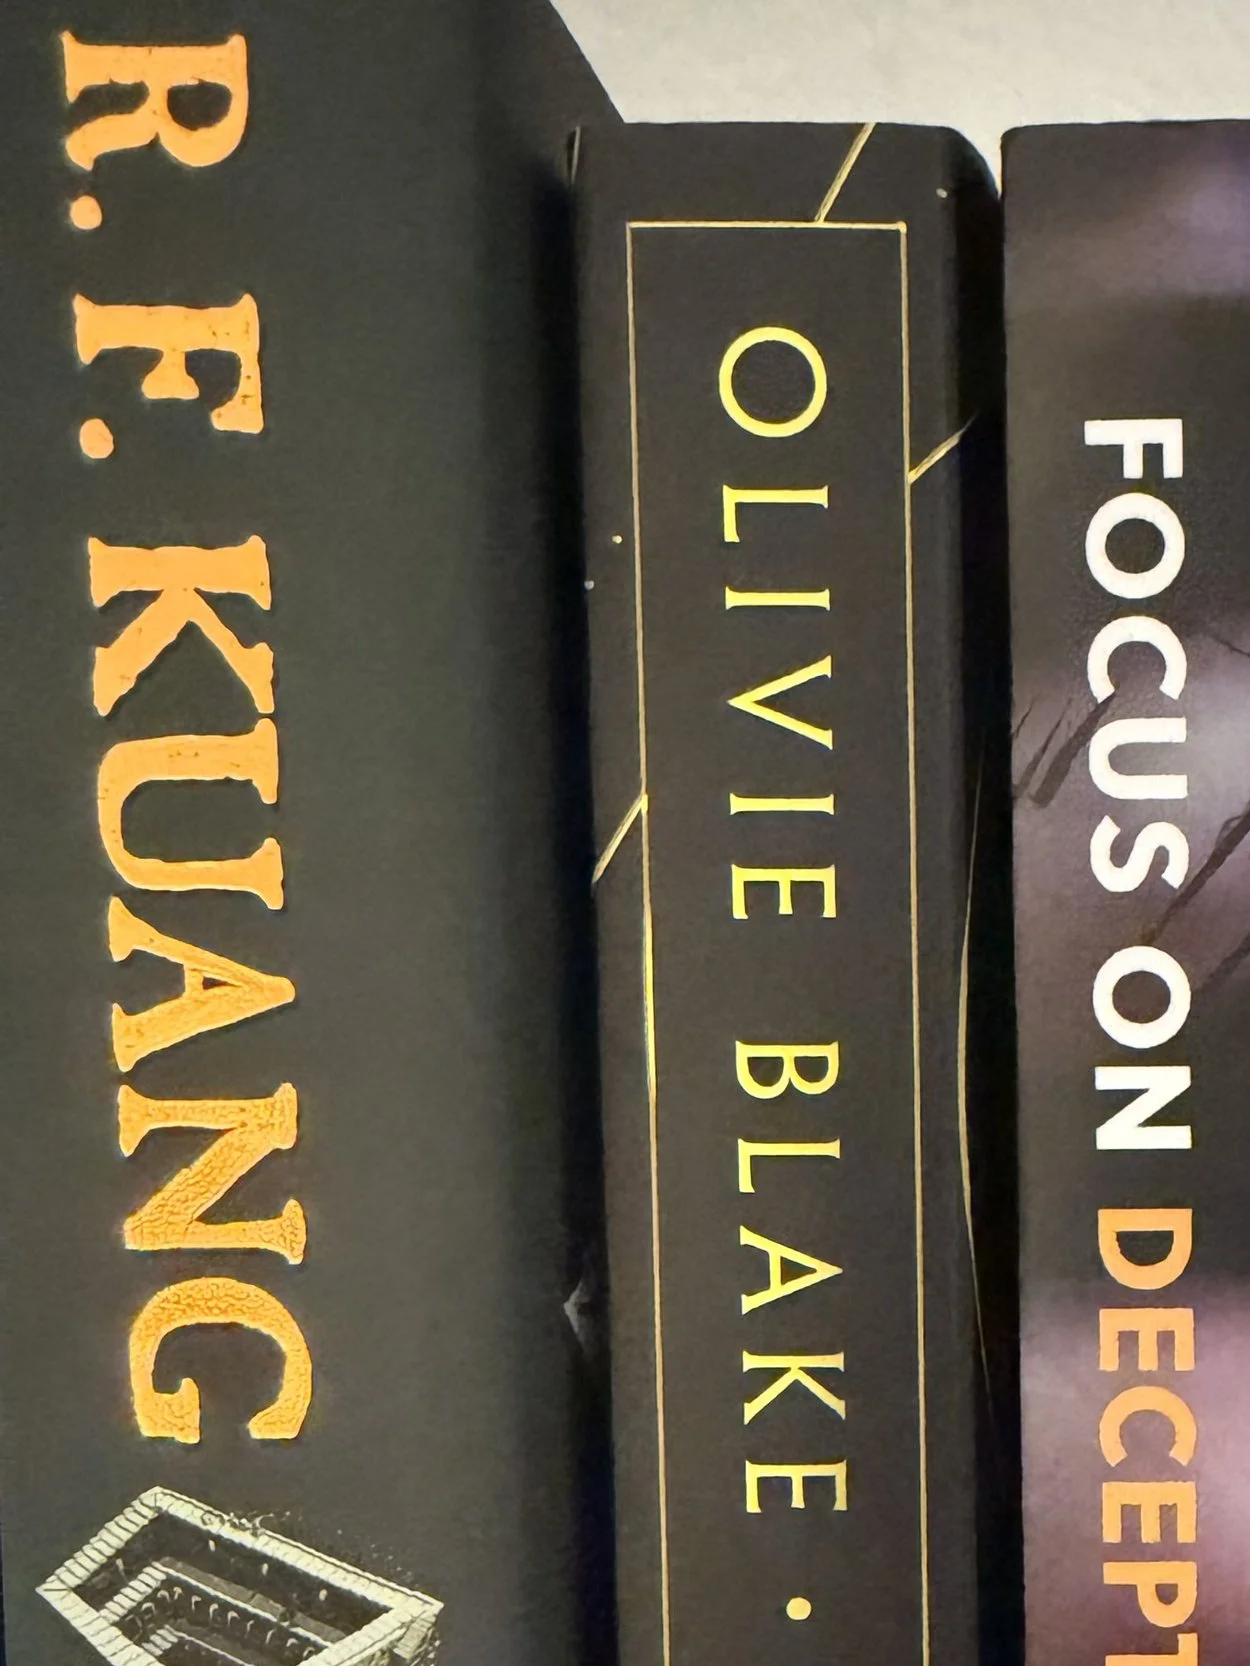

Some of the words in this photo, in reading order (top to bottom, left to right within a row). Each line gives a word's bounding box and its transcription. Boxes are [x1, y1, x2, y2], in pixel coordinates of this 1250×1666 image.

[61, 31, 248, 229] R.
[73, 293, 264, 459] F.
[719, 326, 837, 920] OLIVIE
[1084, 417, 1189, 892] FOCUS
[88, 535, 312, 1443] KUANG
[1092, 944, 1193, 1151] ON
[735, 1039, 848, 1514] BLAKE
